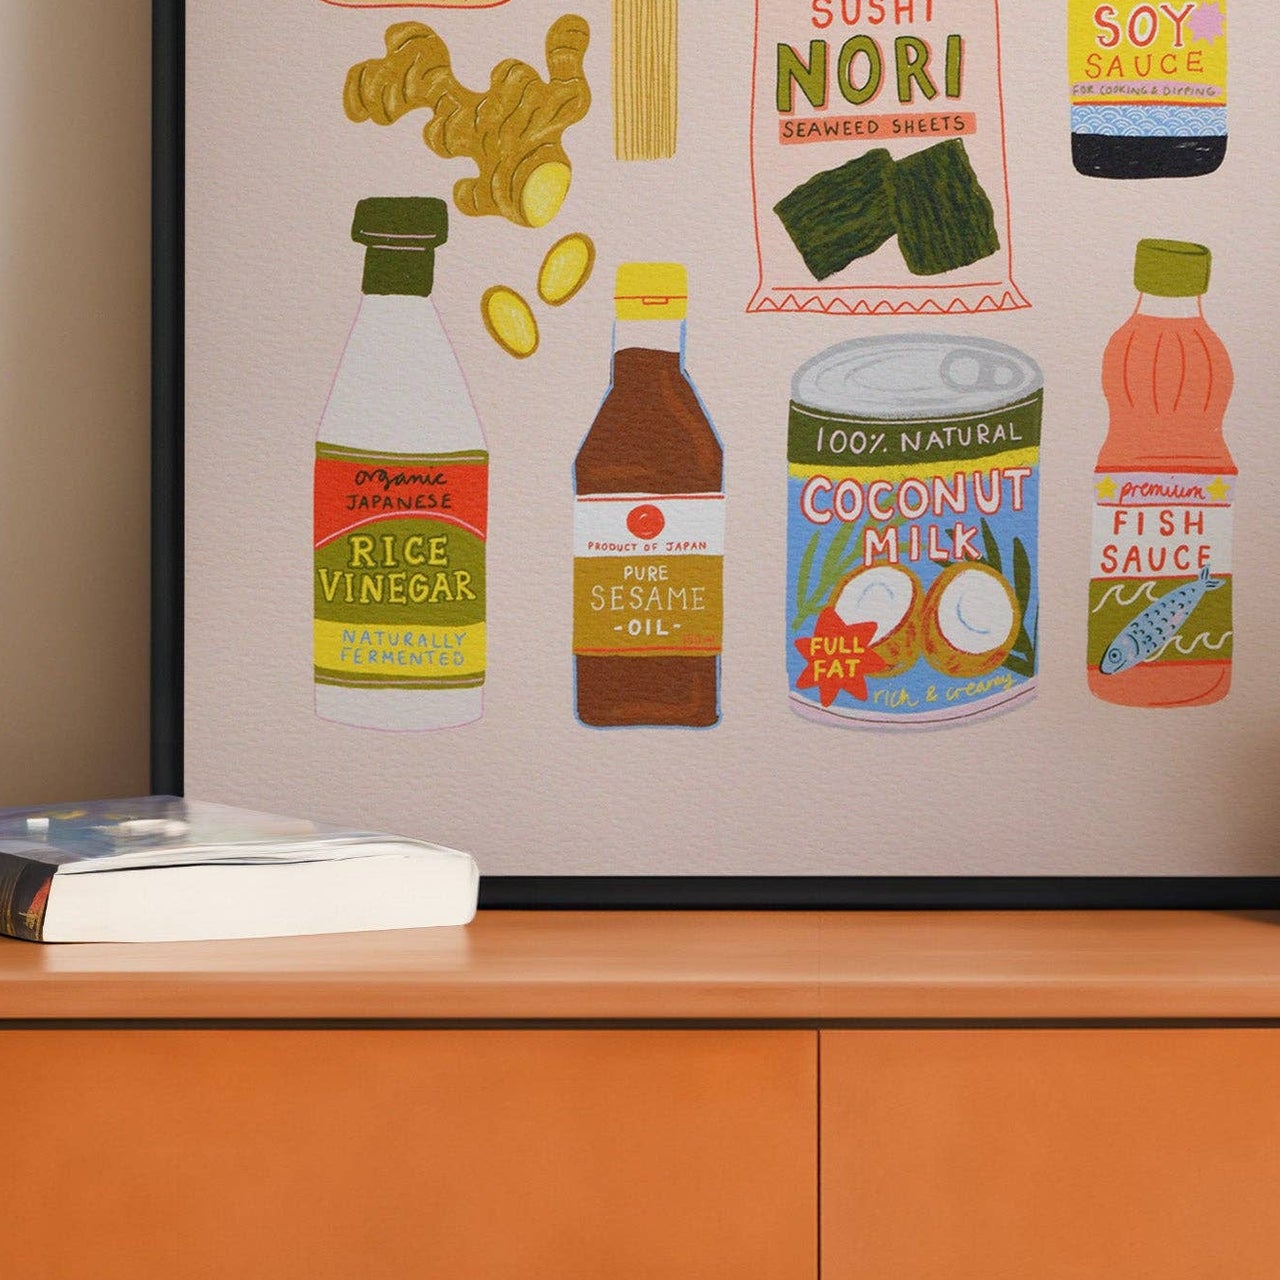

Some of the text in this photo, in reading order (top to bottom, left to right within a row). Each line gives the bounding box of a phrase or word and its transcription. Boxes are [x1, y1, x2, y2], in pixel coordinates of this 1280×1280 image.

[1093, 4, 1196, 48] SOY
[776, 34, 963, 113] NORI
[1085, 51, 1204, 79] SAUCE
[1072, 85, 1094, 94] FOR
[1100, 85, 1148, 95] COOKING
[1163, 86, 1216, 96] DIPPING
[782, 115, 966, 139] SEAWEED SHEETS
[816, 422, 1022, 455] 100% NATURAL
[355, 466, 447, 491] organic
[1119, 477, 1206, 503] premium
[347, 493, 452, 510] JAPANESE
[800, 467, 1032, 524] COCONUT
[1113, 510, 1204, 536] FISH
[349, 534, 449, 568] RICE
[587, 541, 708, 552] PRODUCT OF JAPAN
[863, 522, 982, 567] MILK
[1100, 545, 1211, 573] SAUCE
[623, 565, 669, 581] PURE
[318, 569, 476, 605] VINEGAR
[590, 585, 706, 612] SESAME
[341, 629, 467, 649] NATURALLY
[809, 636, 865, 656] FULL
[340, 646, 465, 667] FERMENTED
[813, 658, 861, 682] FAT
[873, 673, 1016, 708] rich & creamy
